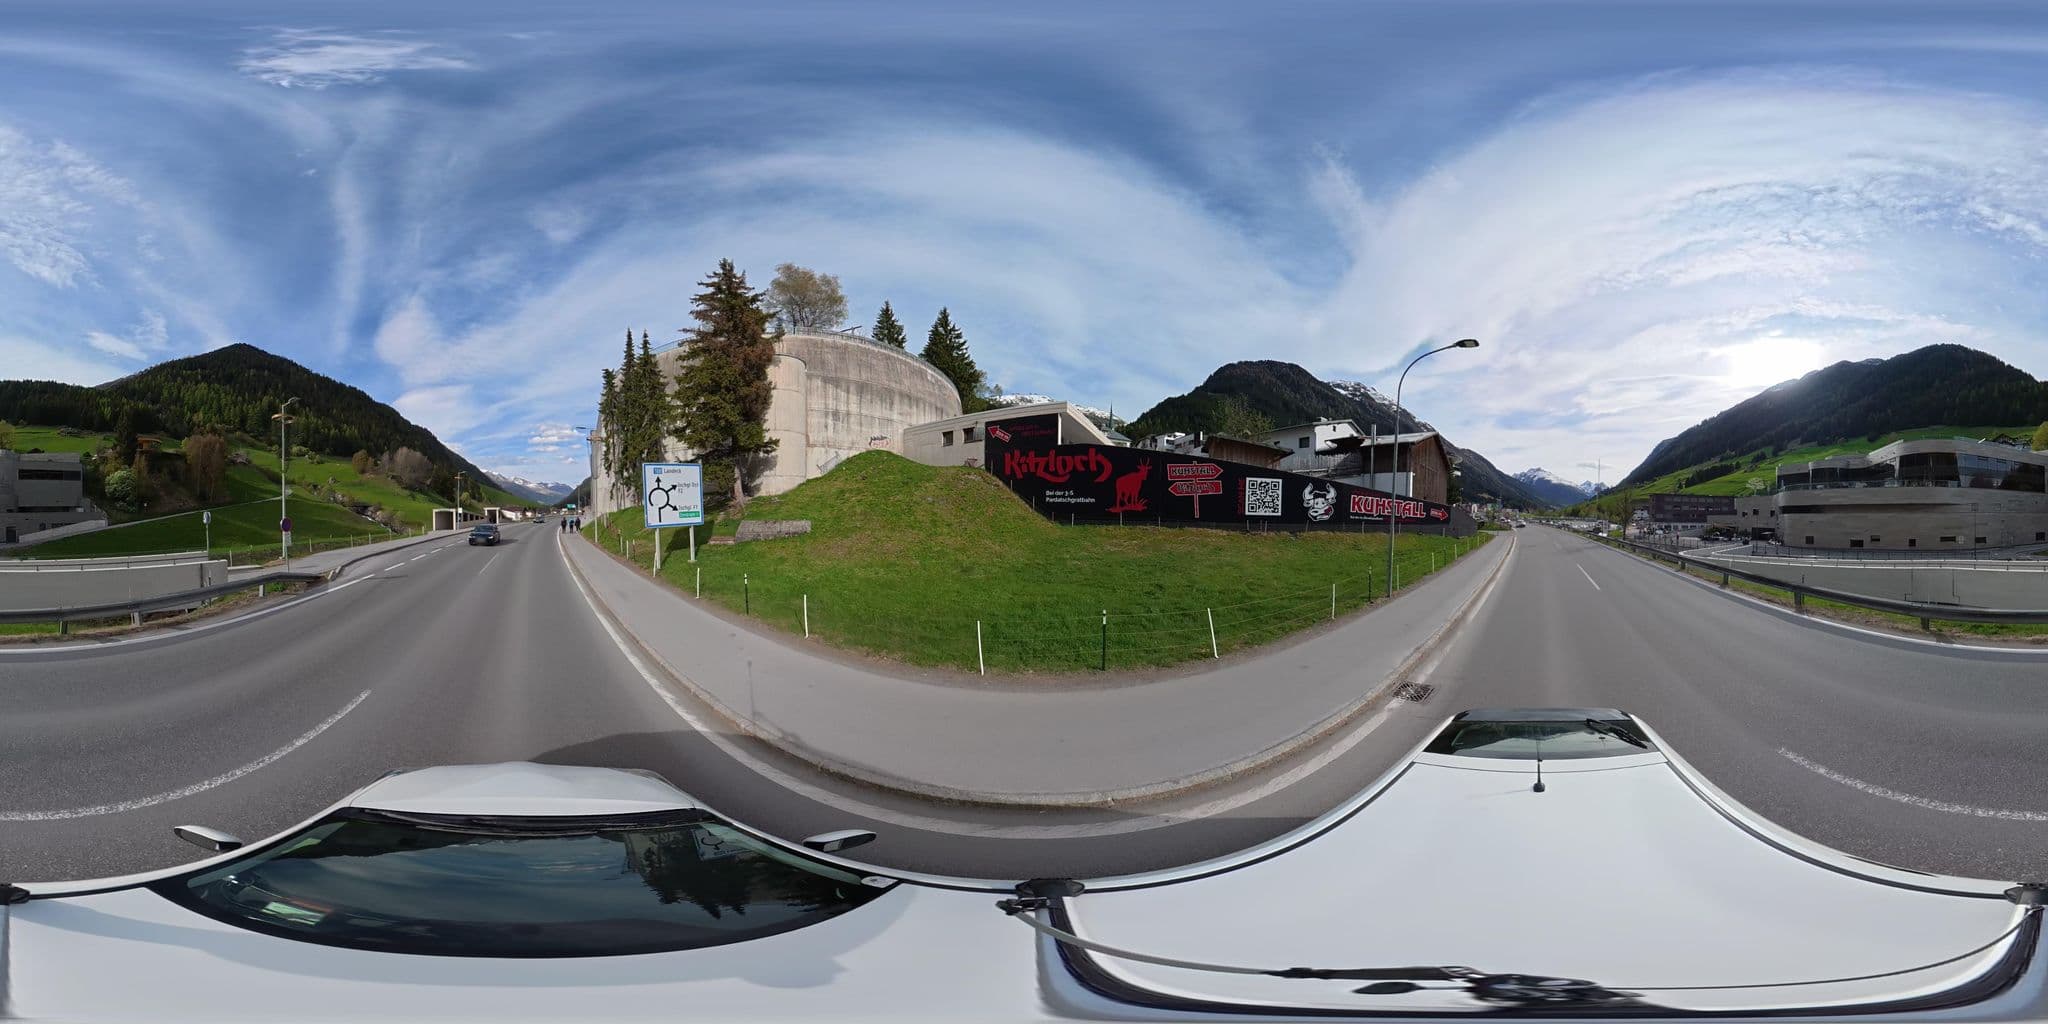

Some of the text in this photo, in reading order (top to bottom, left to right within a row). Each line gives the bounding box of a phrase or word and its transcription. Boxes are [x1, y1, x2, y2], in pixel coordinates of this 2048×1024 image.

[1004, 447, 1113, 484] Kitzloch
[1171, 466, 1216, 475] KUHSTALL
[1350, 494, 1426, 519] KUHSTALL
